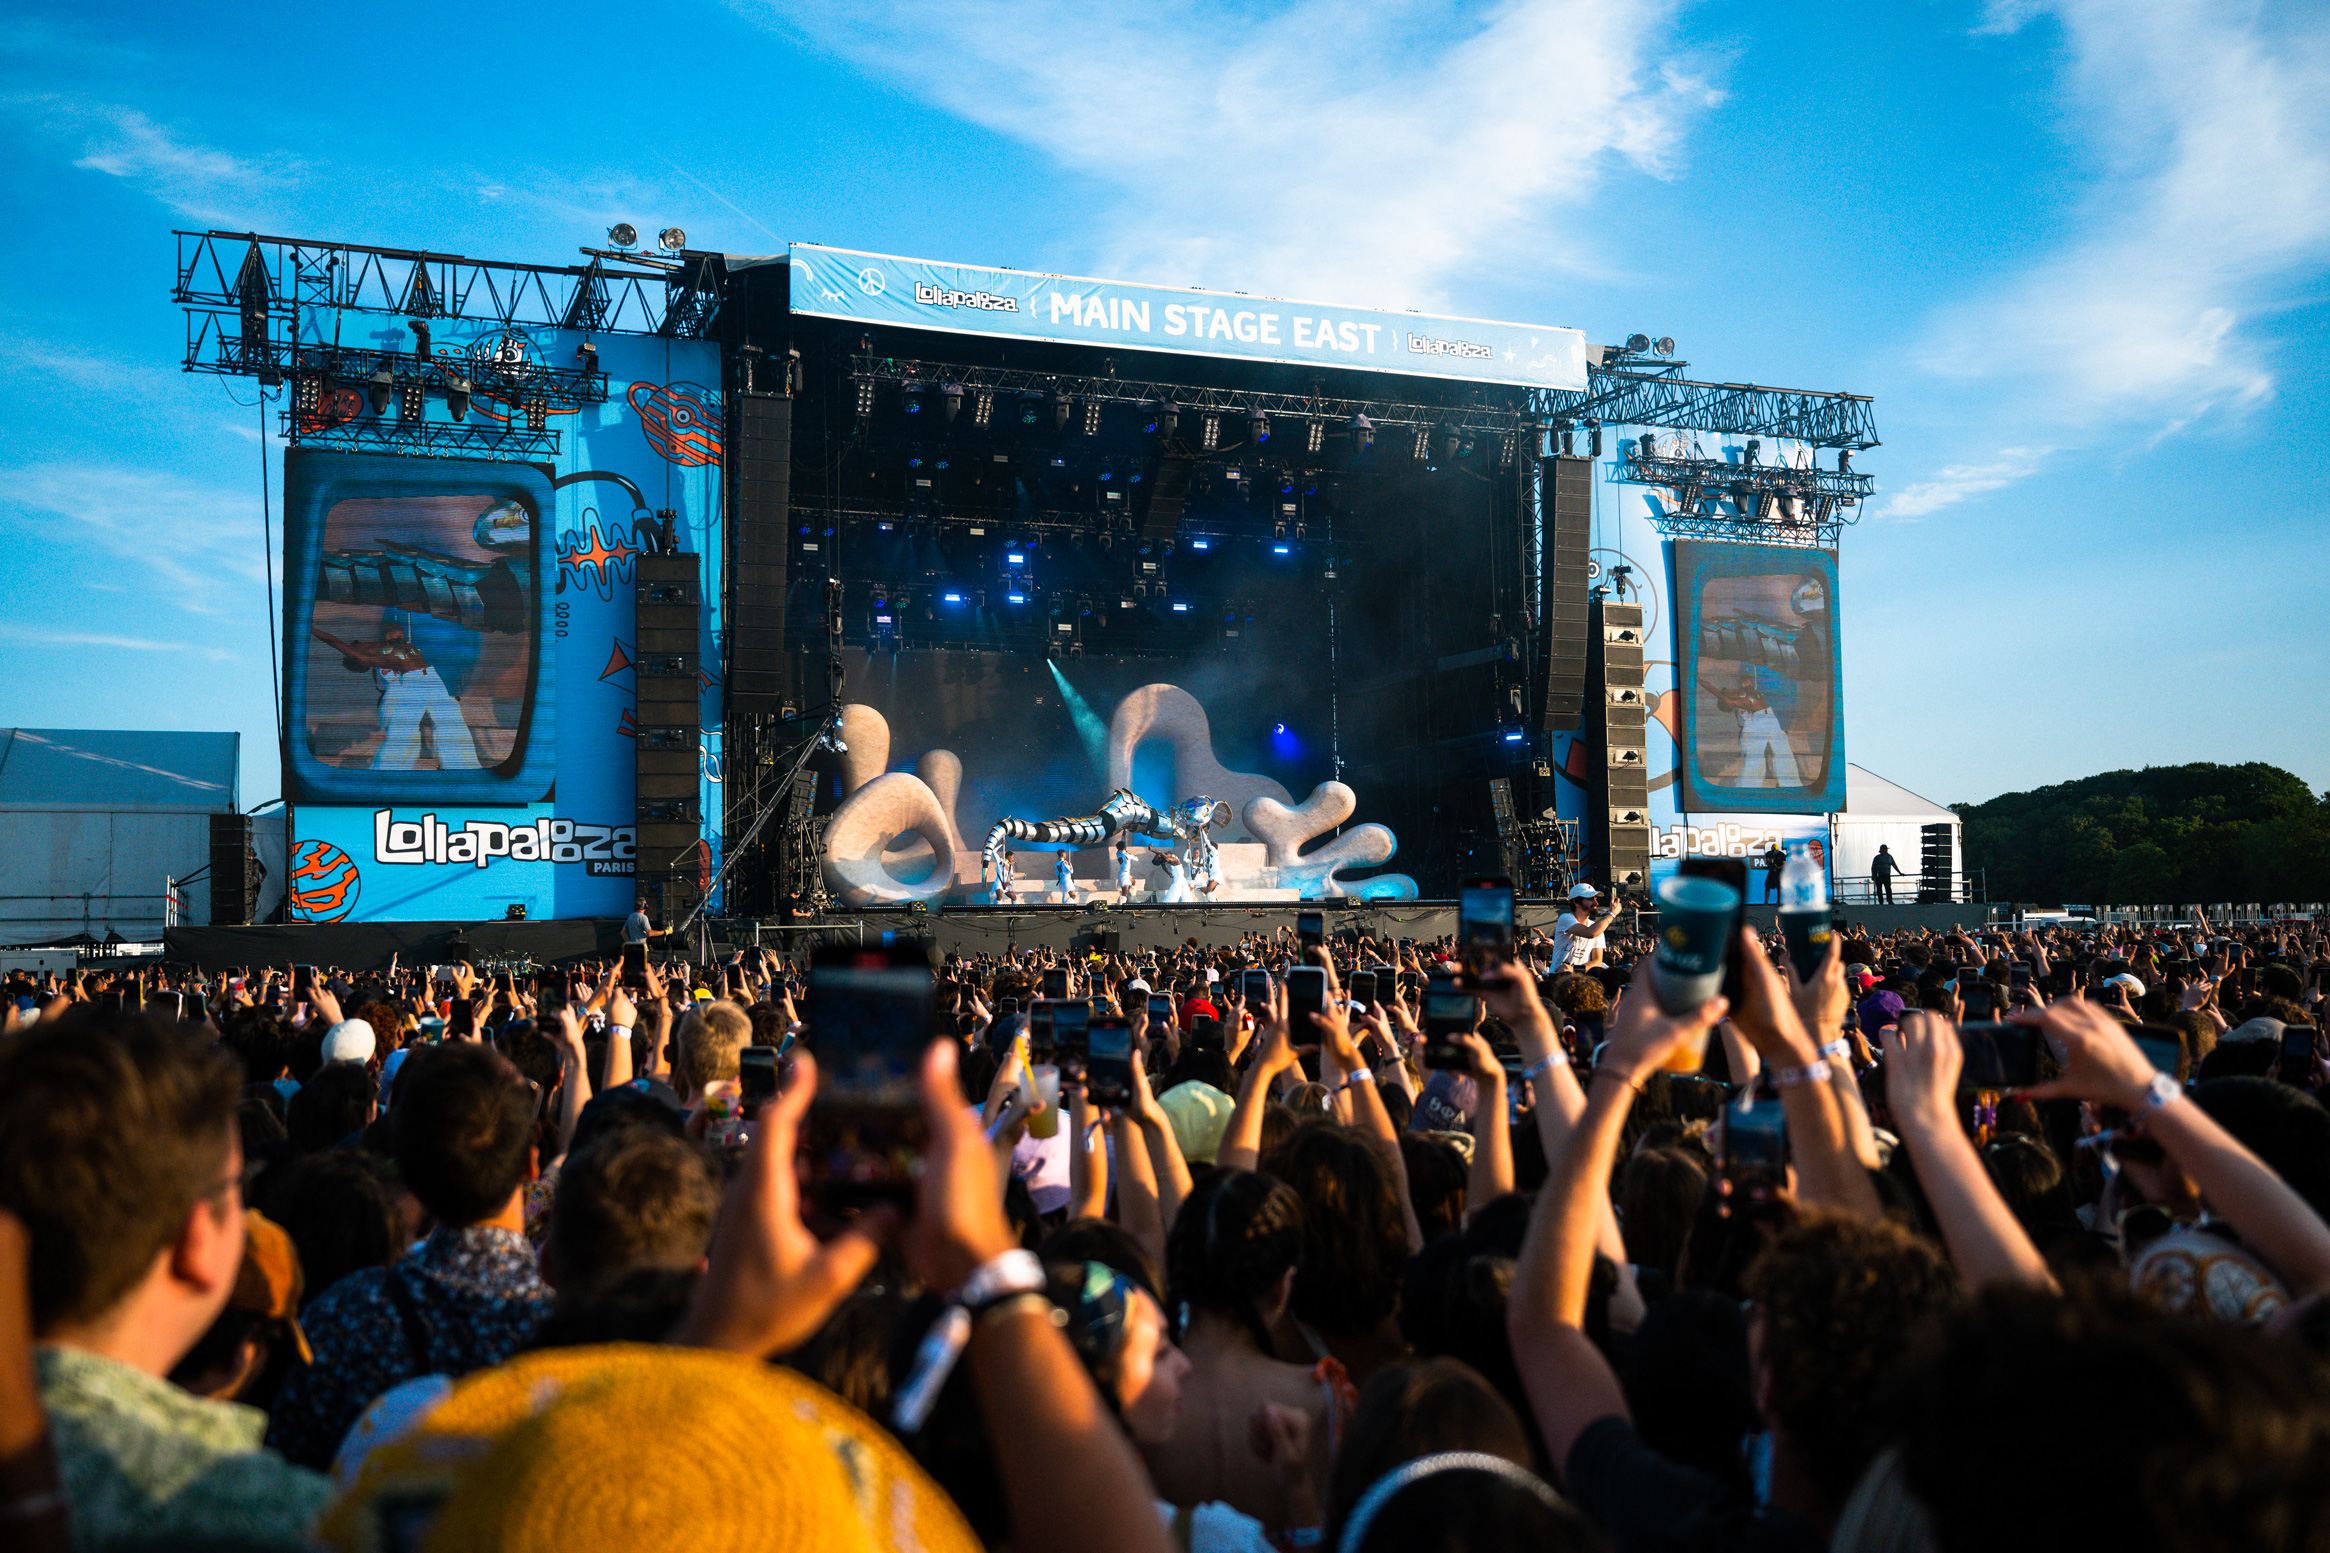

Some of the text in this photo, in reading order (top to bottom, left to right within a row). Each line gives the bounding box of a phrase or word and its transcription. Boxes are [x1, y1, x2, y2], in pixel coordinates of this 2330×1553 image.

[915, 281, 1019, 312] Lollapalooza
[1050, 292, 1382, 354] MAIN STAGE EAST
[1407, 332, 1493, 360] Lollapalooza
[593, 861, 635, 873] PARIS
